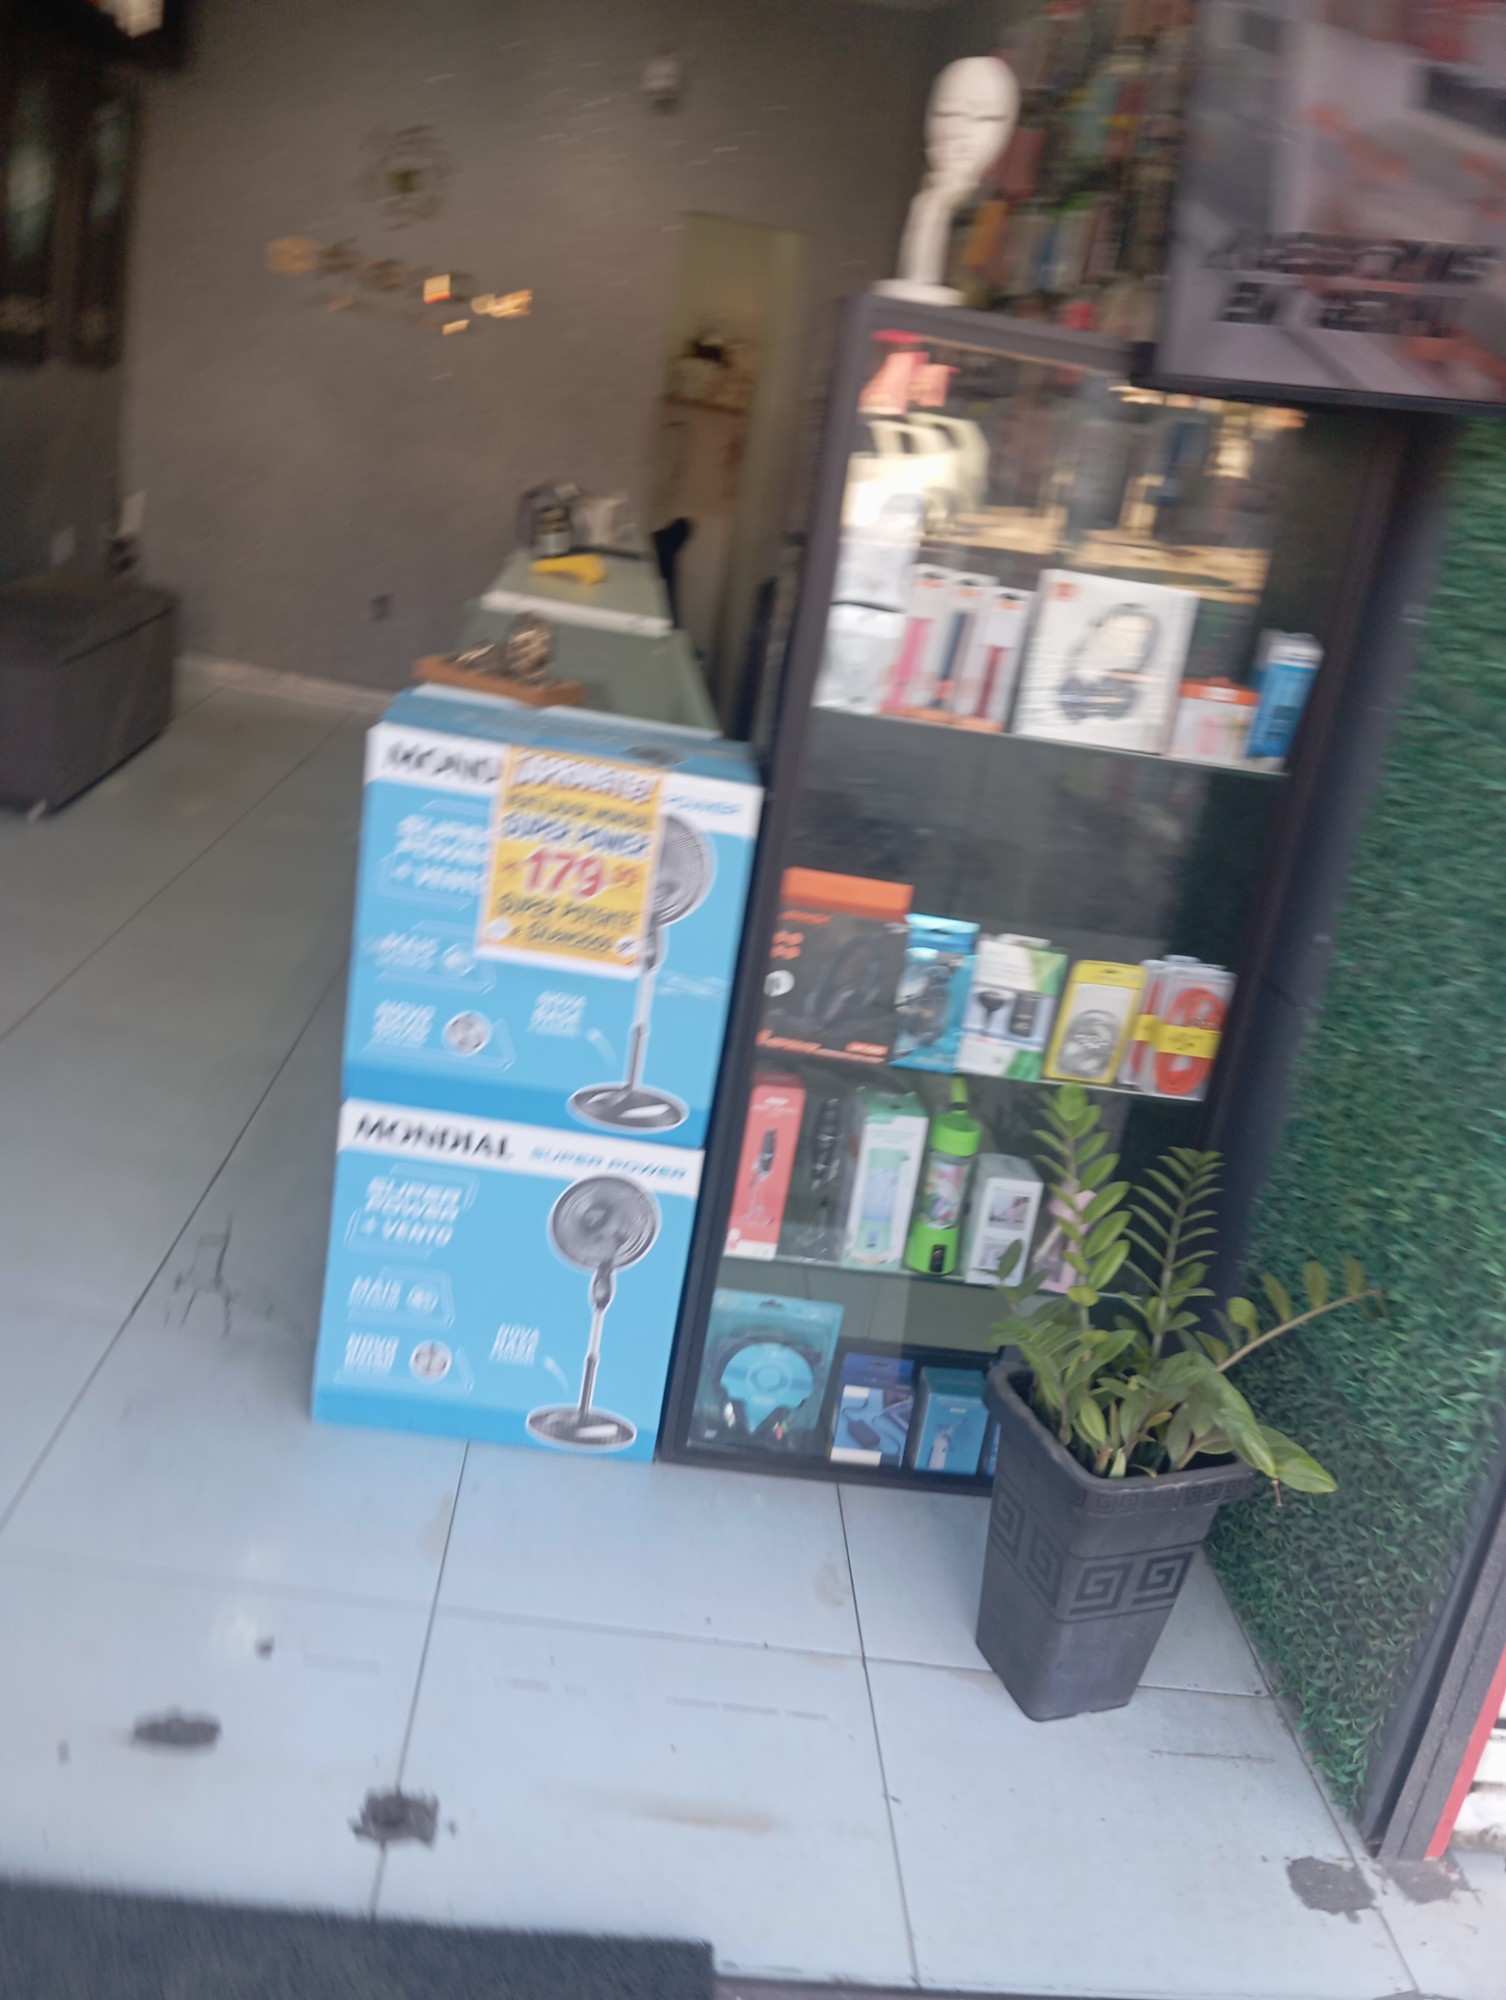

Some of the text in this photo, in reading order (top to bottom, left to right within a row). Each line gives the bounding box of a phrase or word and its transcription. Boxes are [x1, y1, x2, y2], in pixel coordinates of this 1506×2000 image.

[523, 848, 605, 900] 179
[354, 1113, 513, 1161] MONDIAL
[529, 1145, 688, 1182] SUPER POWER
[366, 1176, 465, 1203] SUPER
[381, 1221, 455, 1247] VENTO
